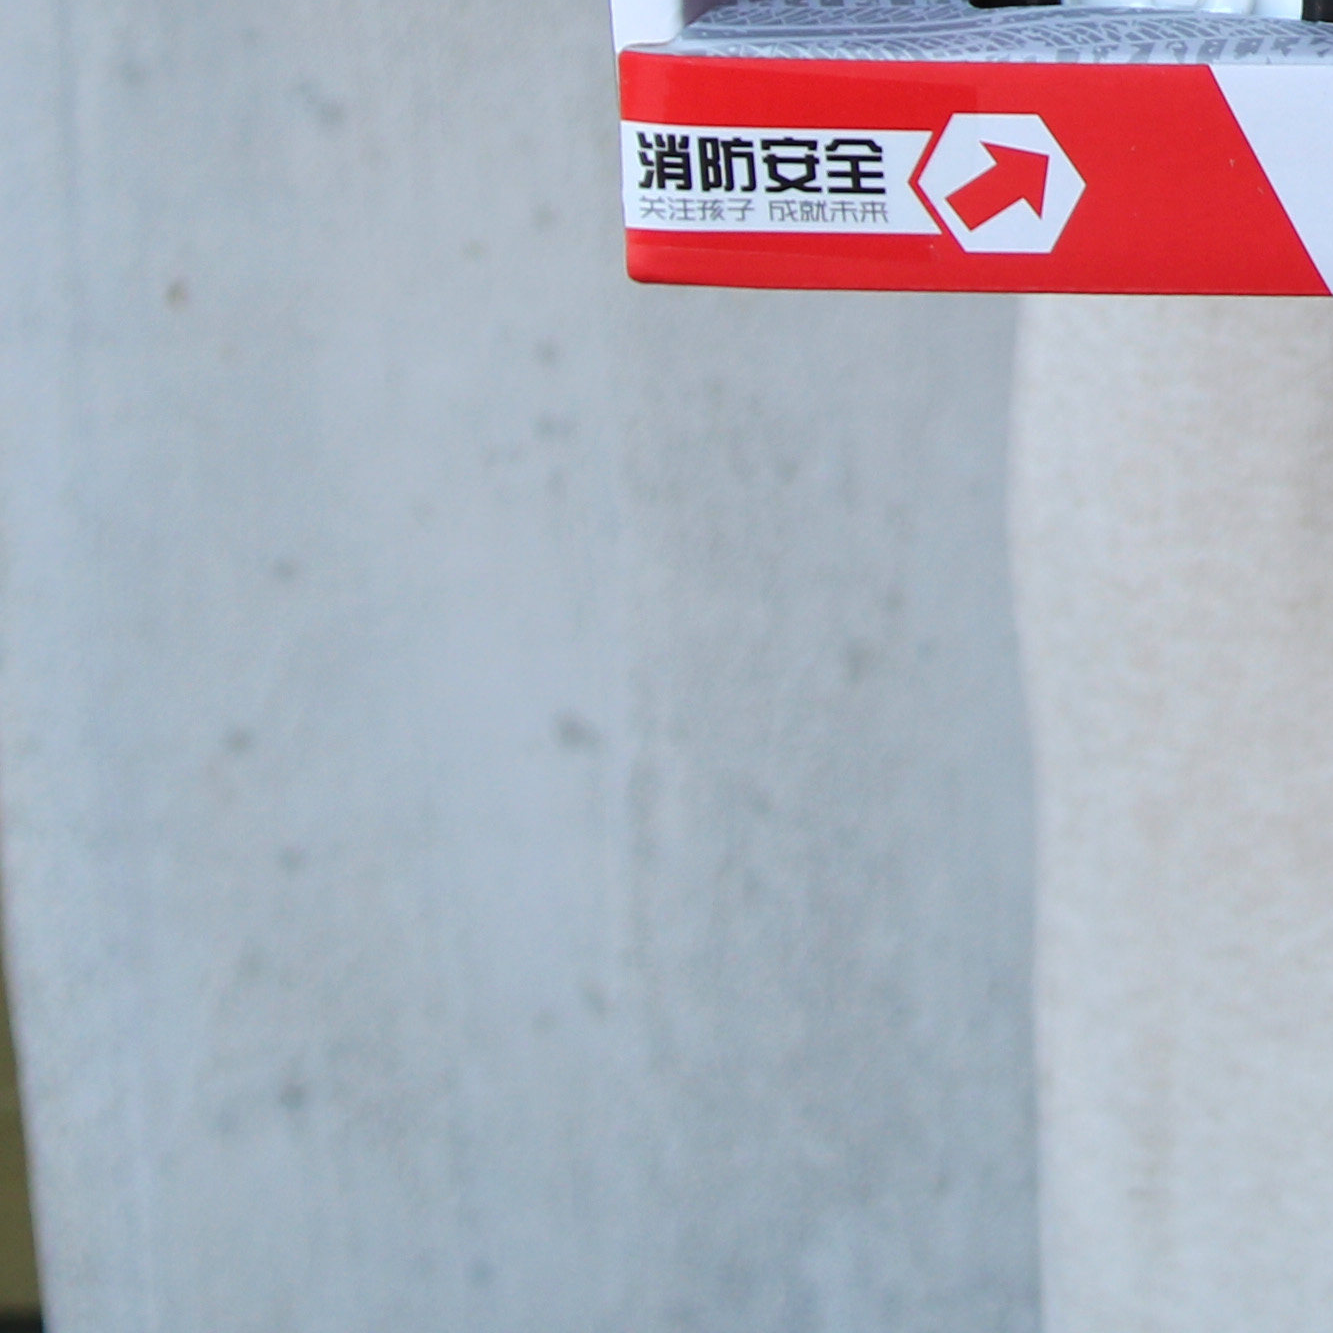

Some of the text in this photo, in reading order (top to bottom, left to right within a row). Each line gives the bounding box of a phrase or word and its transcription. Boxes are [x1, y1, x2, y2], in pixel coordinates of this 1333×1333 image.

[637, 132, 886, 195] 消防安全
[640, 196, 888, 223] 关注孩子 成就未来
